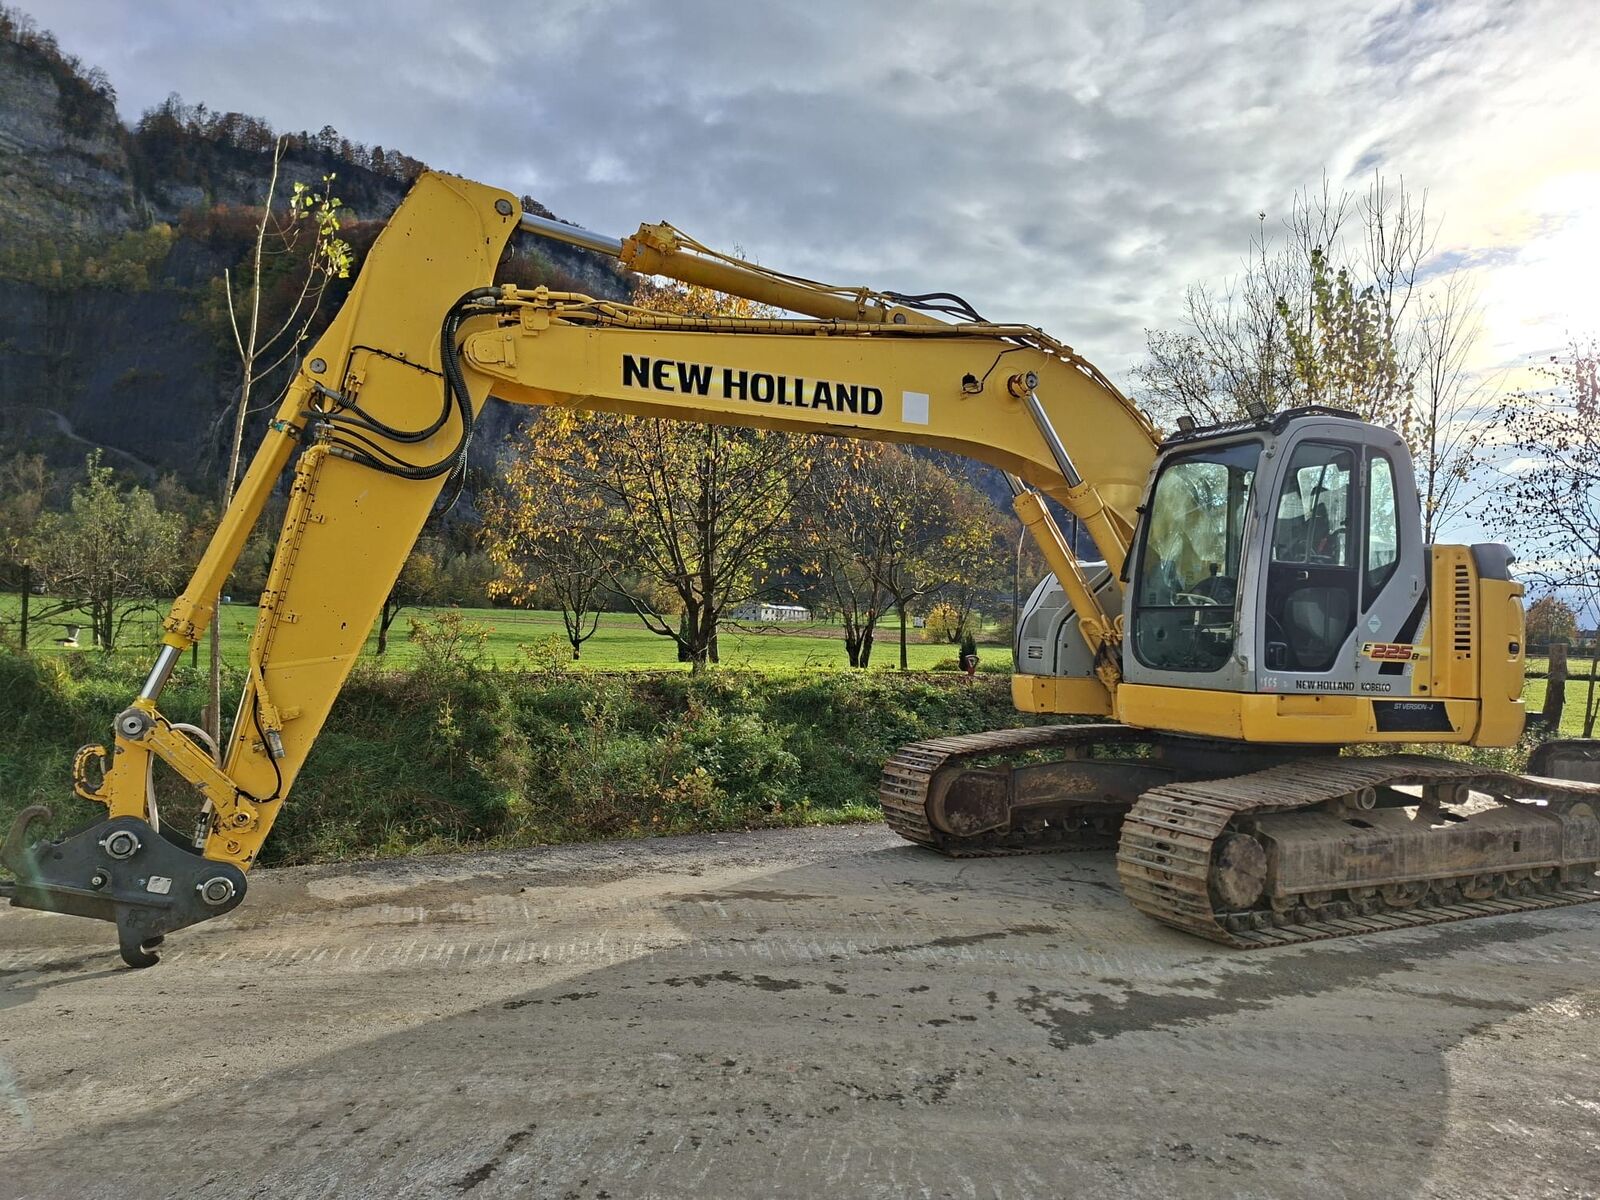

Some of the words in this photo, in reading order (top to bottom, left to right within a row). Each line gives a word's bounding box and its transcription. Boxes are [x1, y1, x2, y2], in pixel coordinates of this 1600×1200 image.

[622, 354, 714, 396] NEW
[722, 368, 884, 416] HOLLAND
[1296, 679, 1316, 690] NEW
[1317, 680, 1355, 692] HOLLAND
[1361, 682, 1392, 692] KOBELCO
